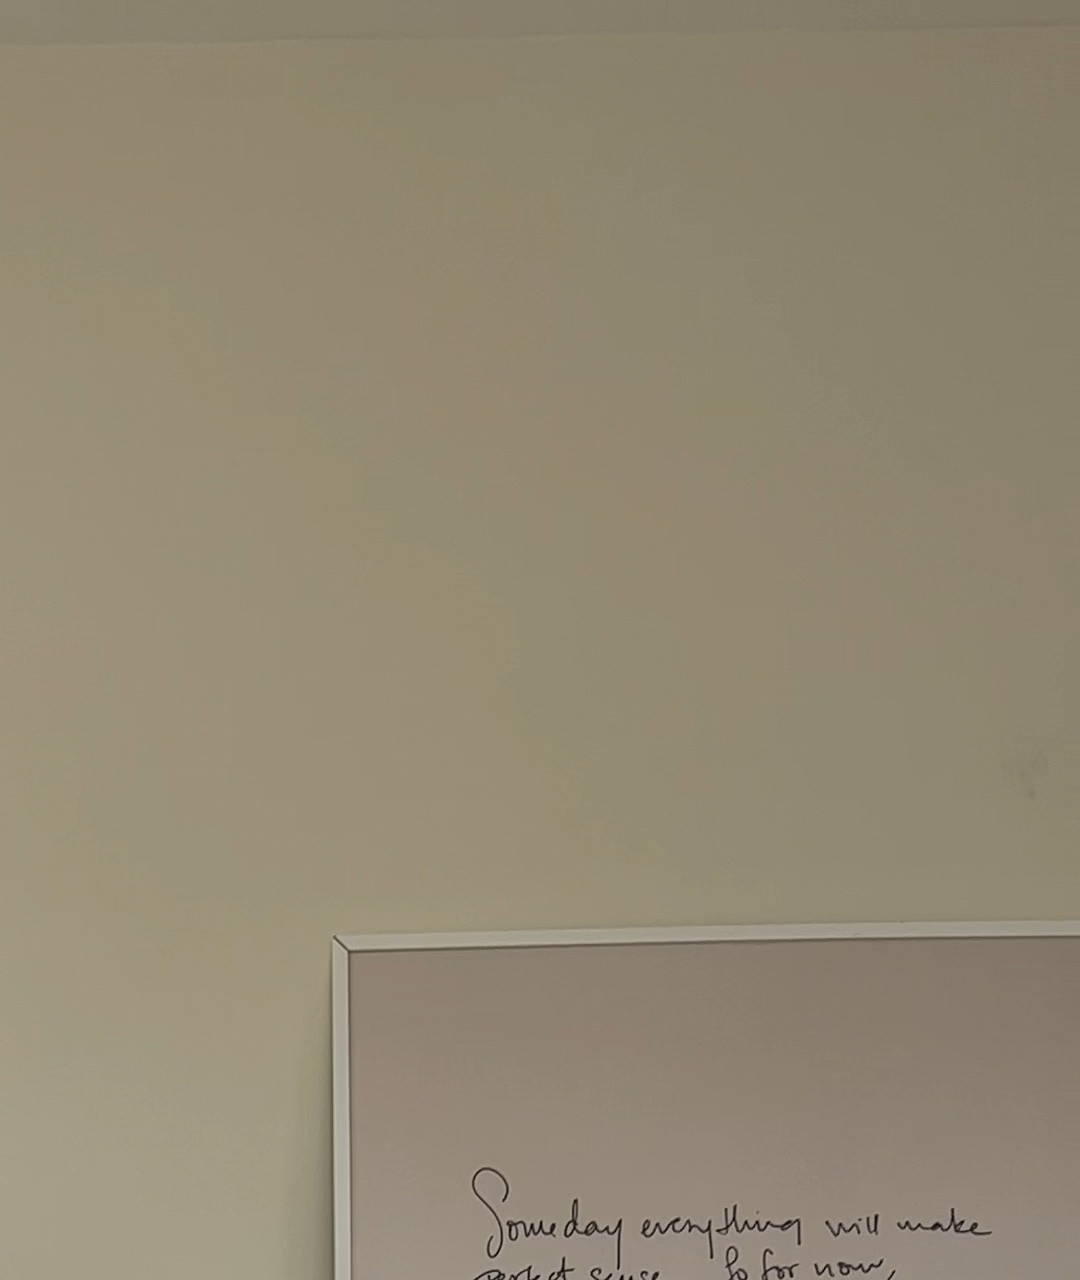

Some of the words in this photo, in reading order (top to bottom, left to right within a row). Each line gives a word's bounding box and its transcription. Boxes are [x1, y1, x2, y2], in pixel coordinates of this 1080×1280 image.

[472, 1167, 622, 1270] Someday
[641, 1204, 801, 1259] everything
[825, 1214, 879, 1237] will
[897, 1208, 992, 1236] make
